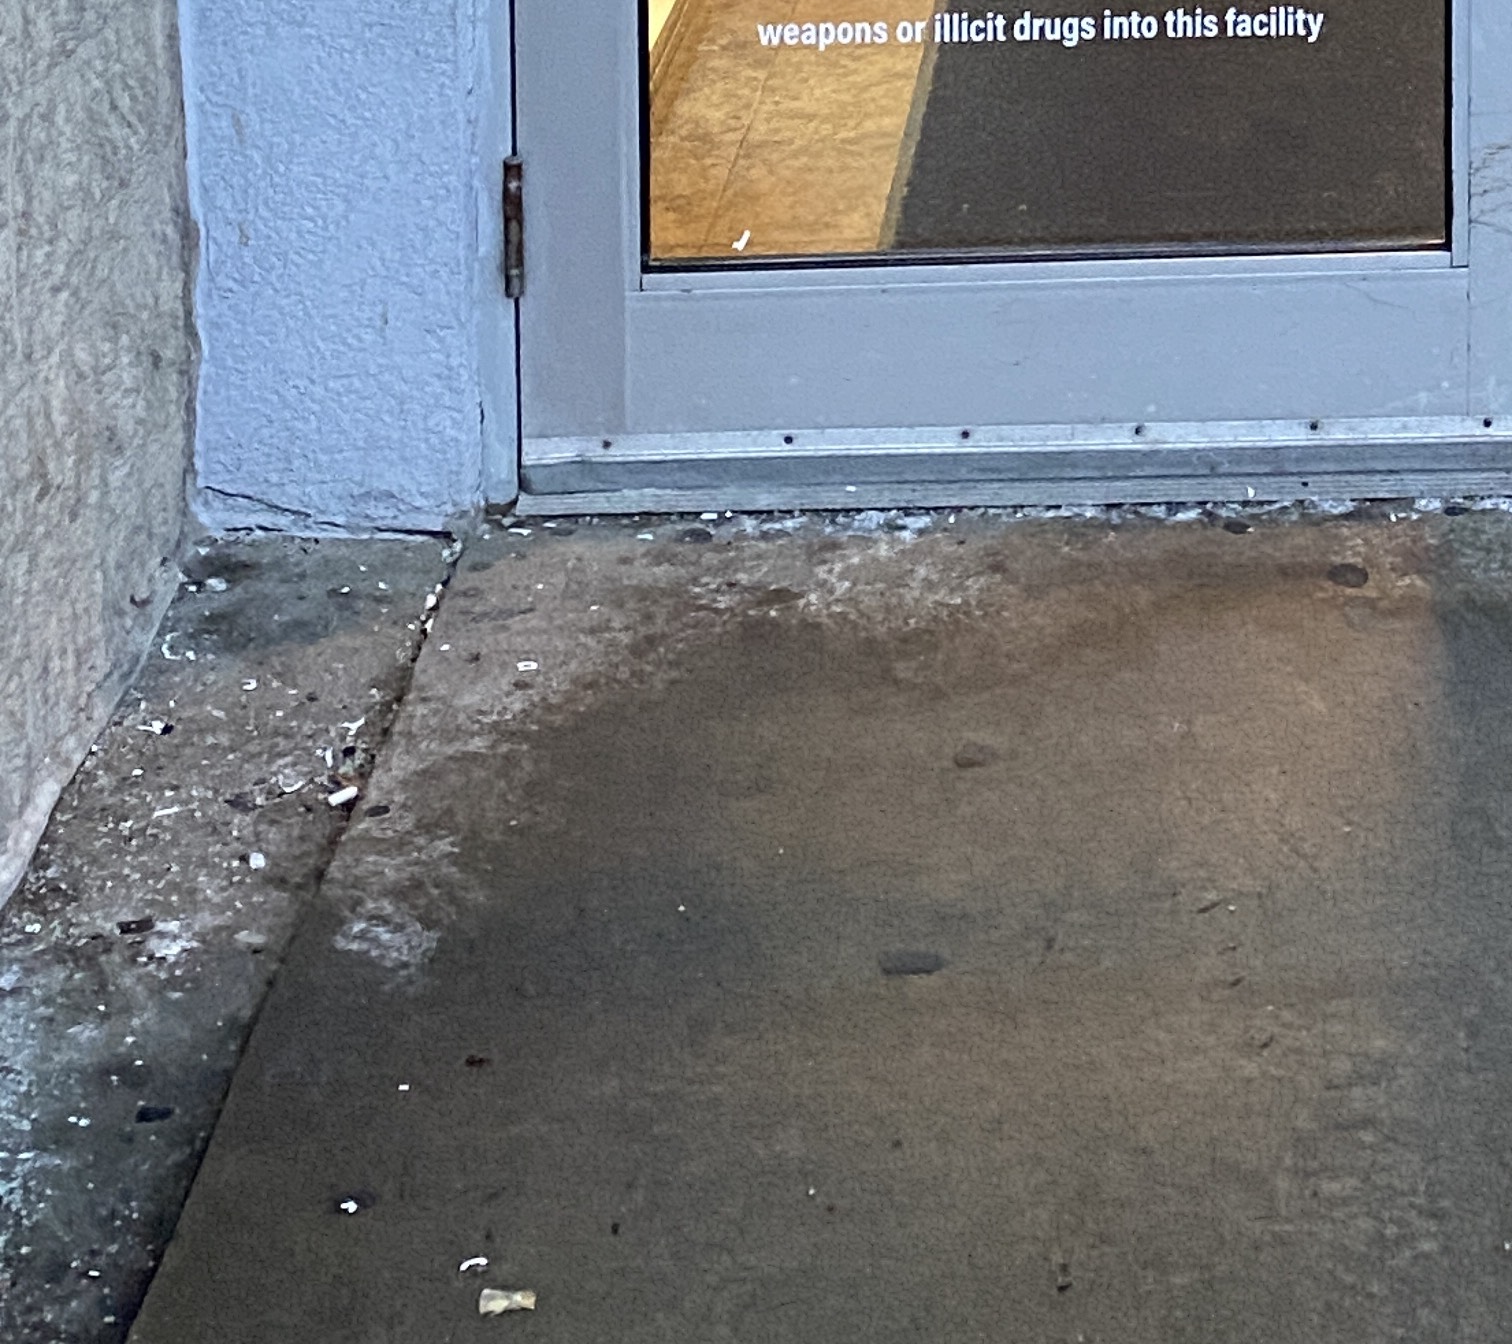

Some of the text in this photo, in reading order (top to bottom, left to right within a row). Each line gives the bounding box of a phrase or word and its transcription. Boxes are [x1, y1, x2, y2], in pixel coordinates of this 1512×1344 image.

[757, 6, 1324, 52] weapons or illicit drugs into this facility
